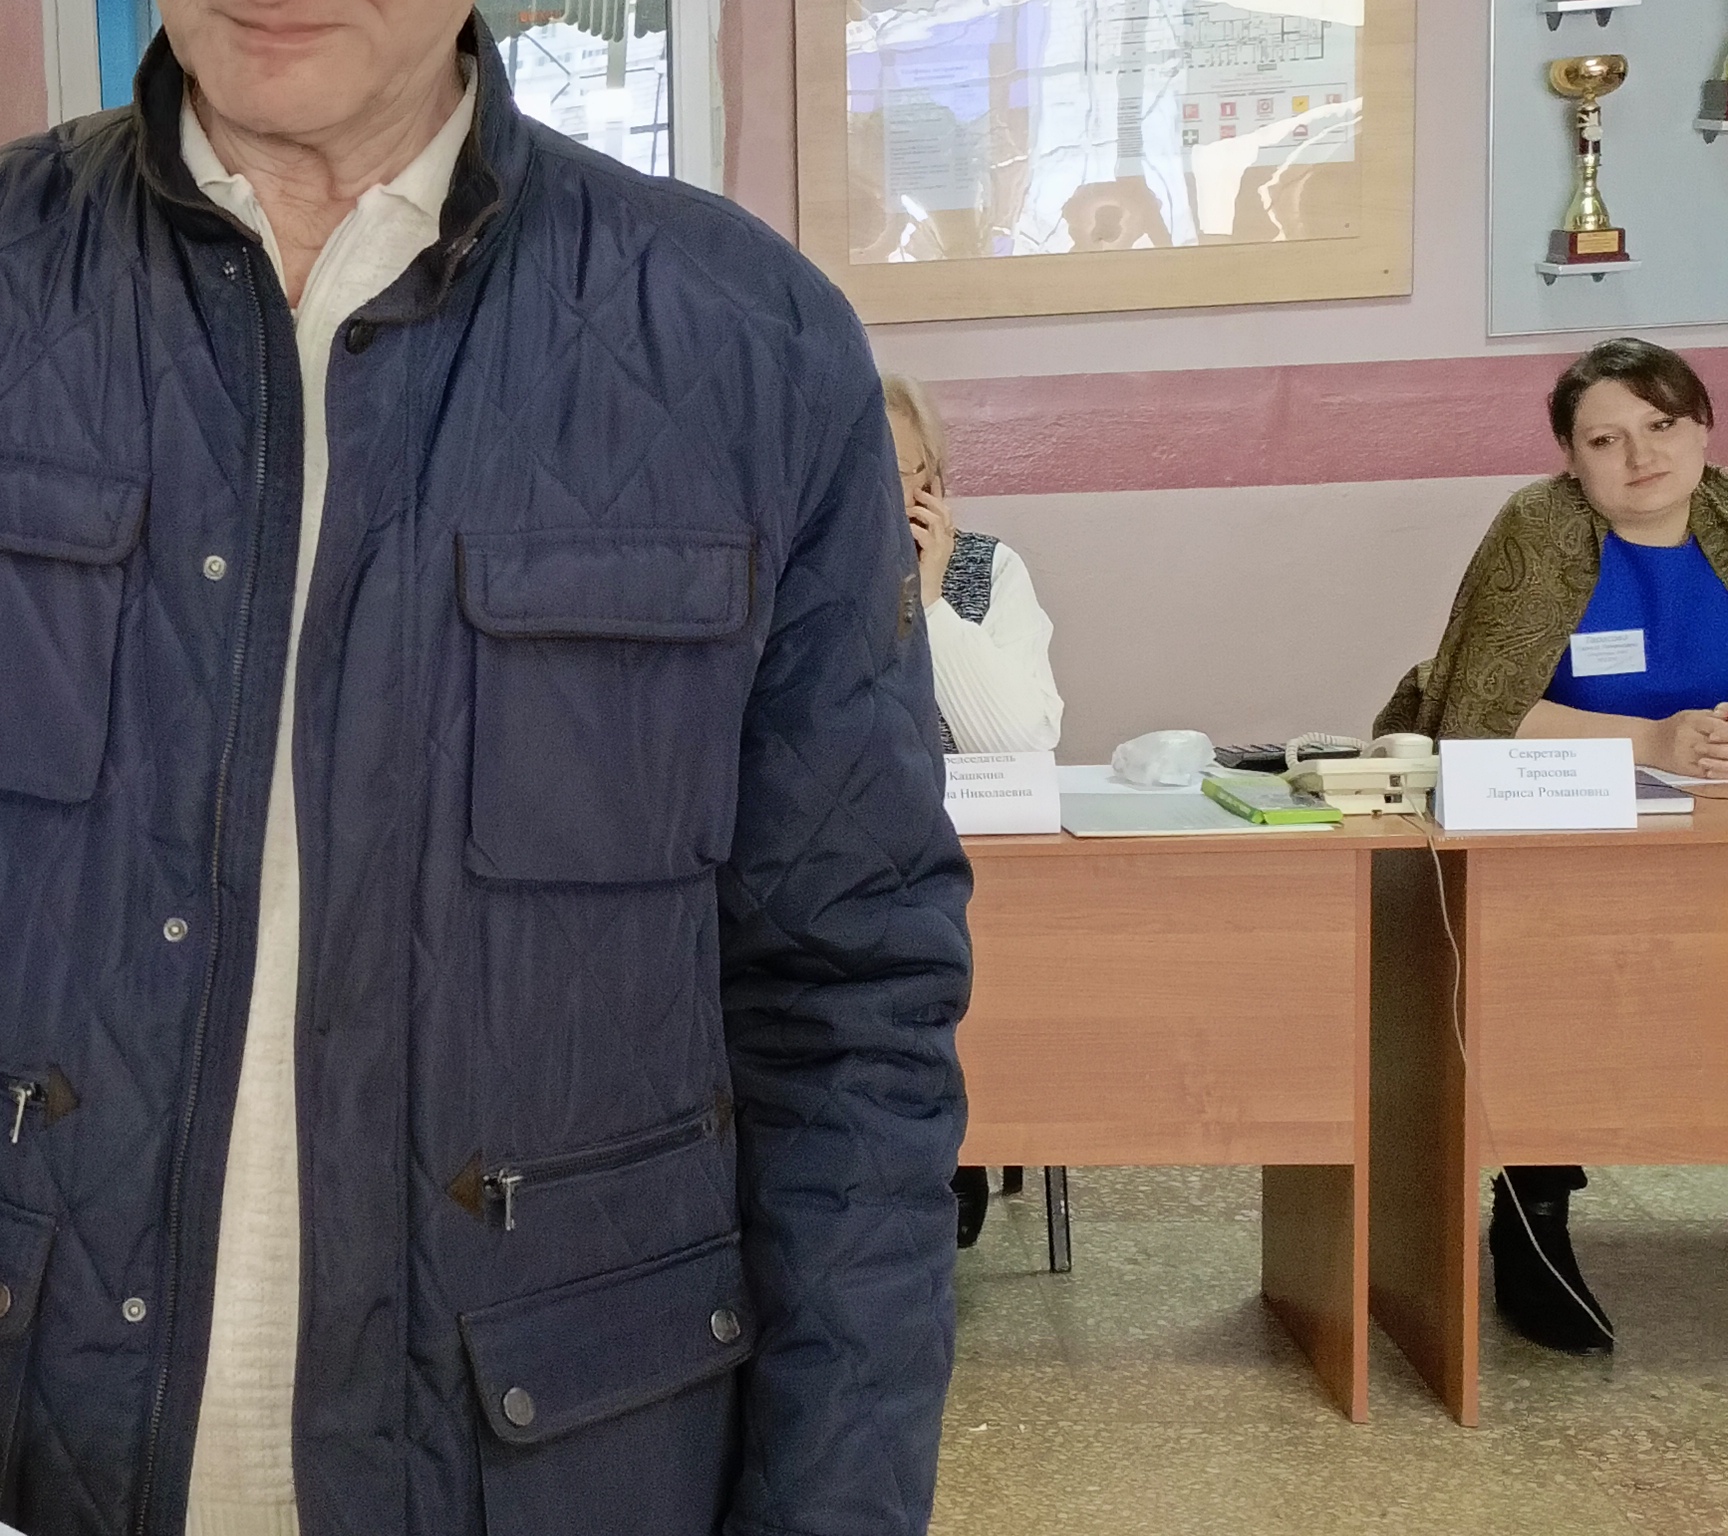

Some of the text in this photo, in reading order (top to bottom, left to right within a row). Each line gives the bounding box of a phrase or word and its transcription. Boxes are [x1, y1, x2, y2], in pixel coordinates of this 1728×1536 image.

[1509, 748, 1576, 760] Секретарь
[950, 771, 1004, 781] Кашкина
[1517, 767, 1577, 780] Тарасова
[960, 788, 1033, 799] Николаевна
[1486, 787, 1610, 800] Лариса Романовна
